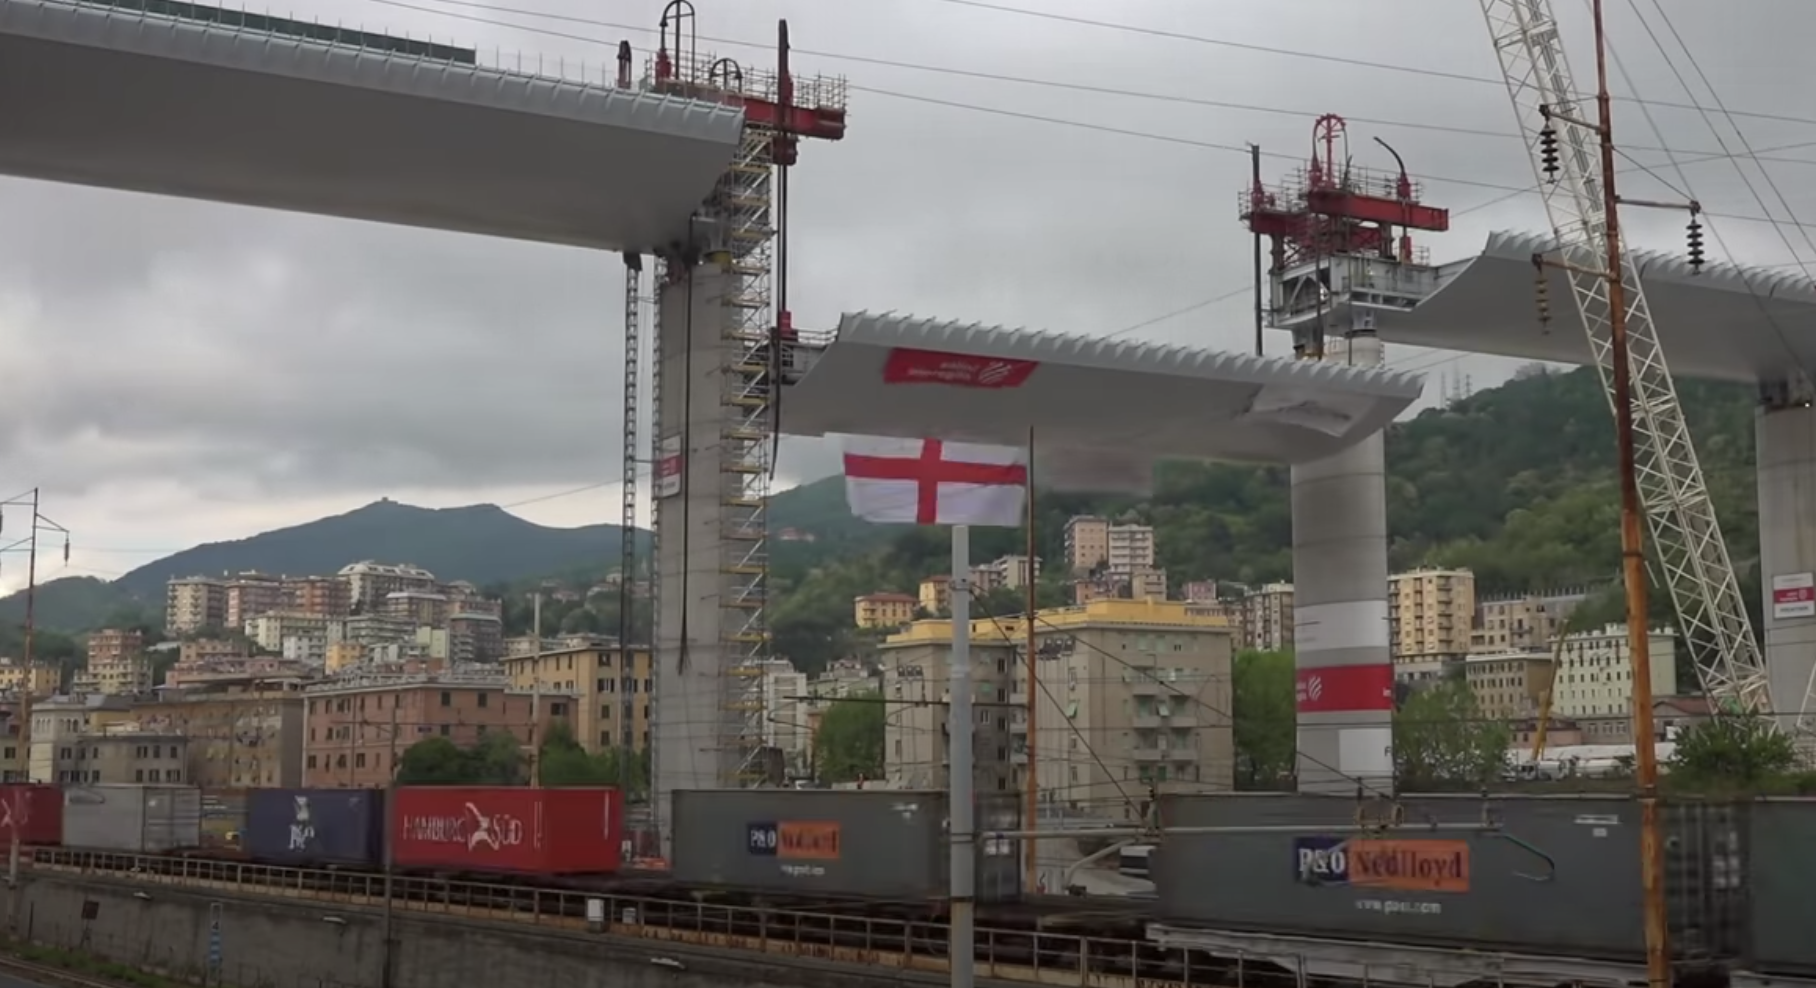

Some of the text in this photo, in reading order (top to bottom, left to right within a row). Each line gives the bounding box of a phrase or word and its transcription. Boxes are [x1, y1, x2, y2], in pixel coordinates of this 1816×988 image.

[491, 813, 523, 845] SÜD
[1299, 848, 1463, 887] P&O Nedlloyd
